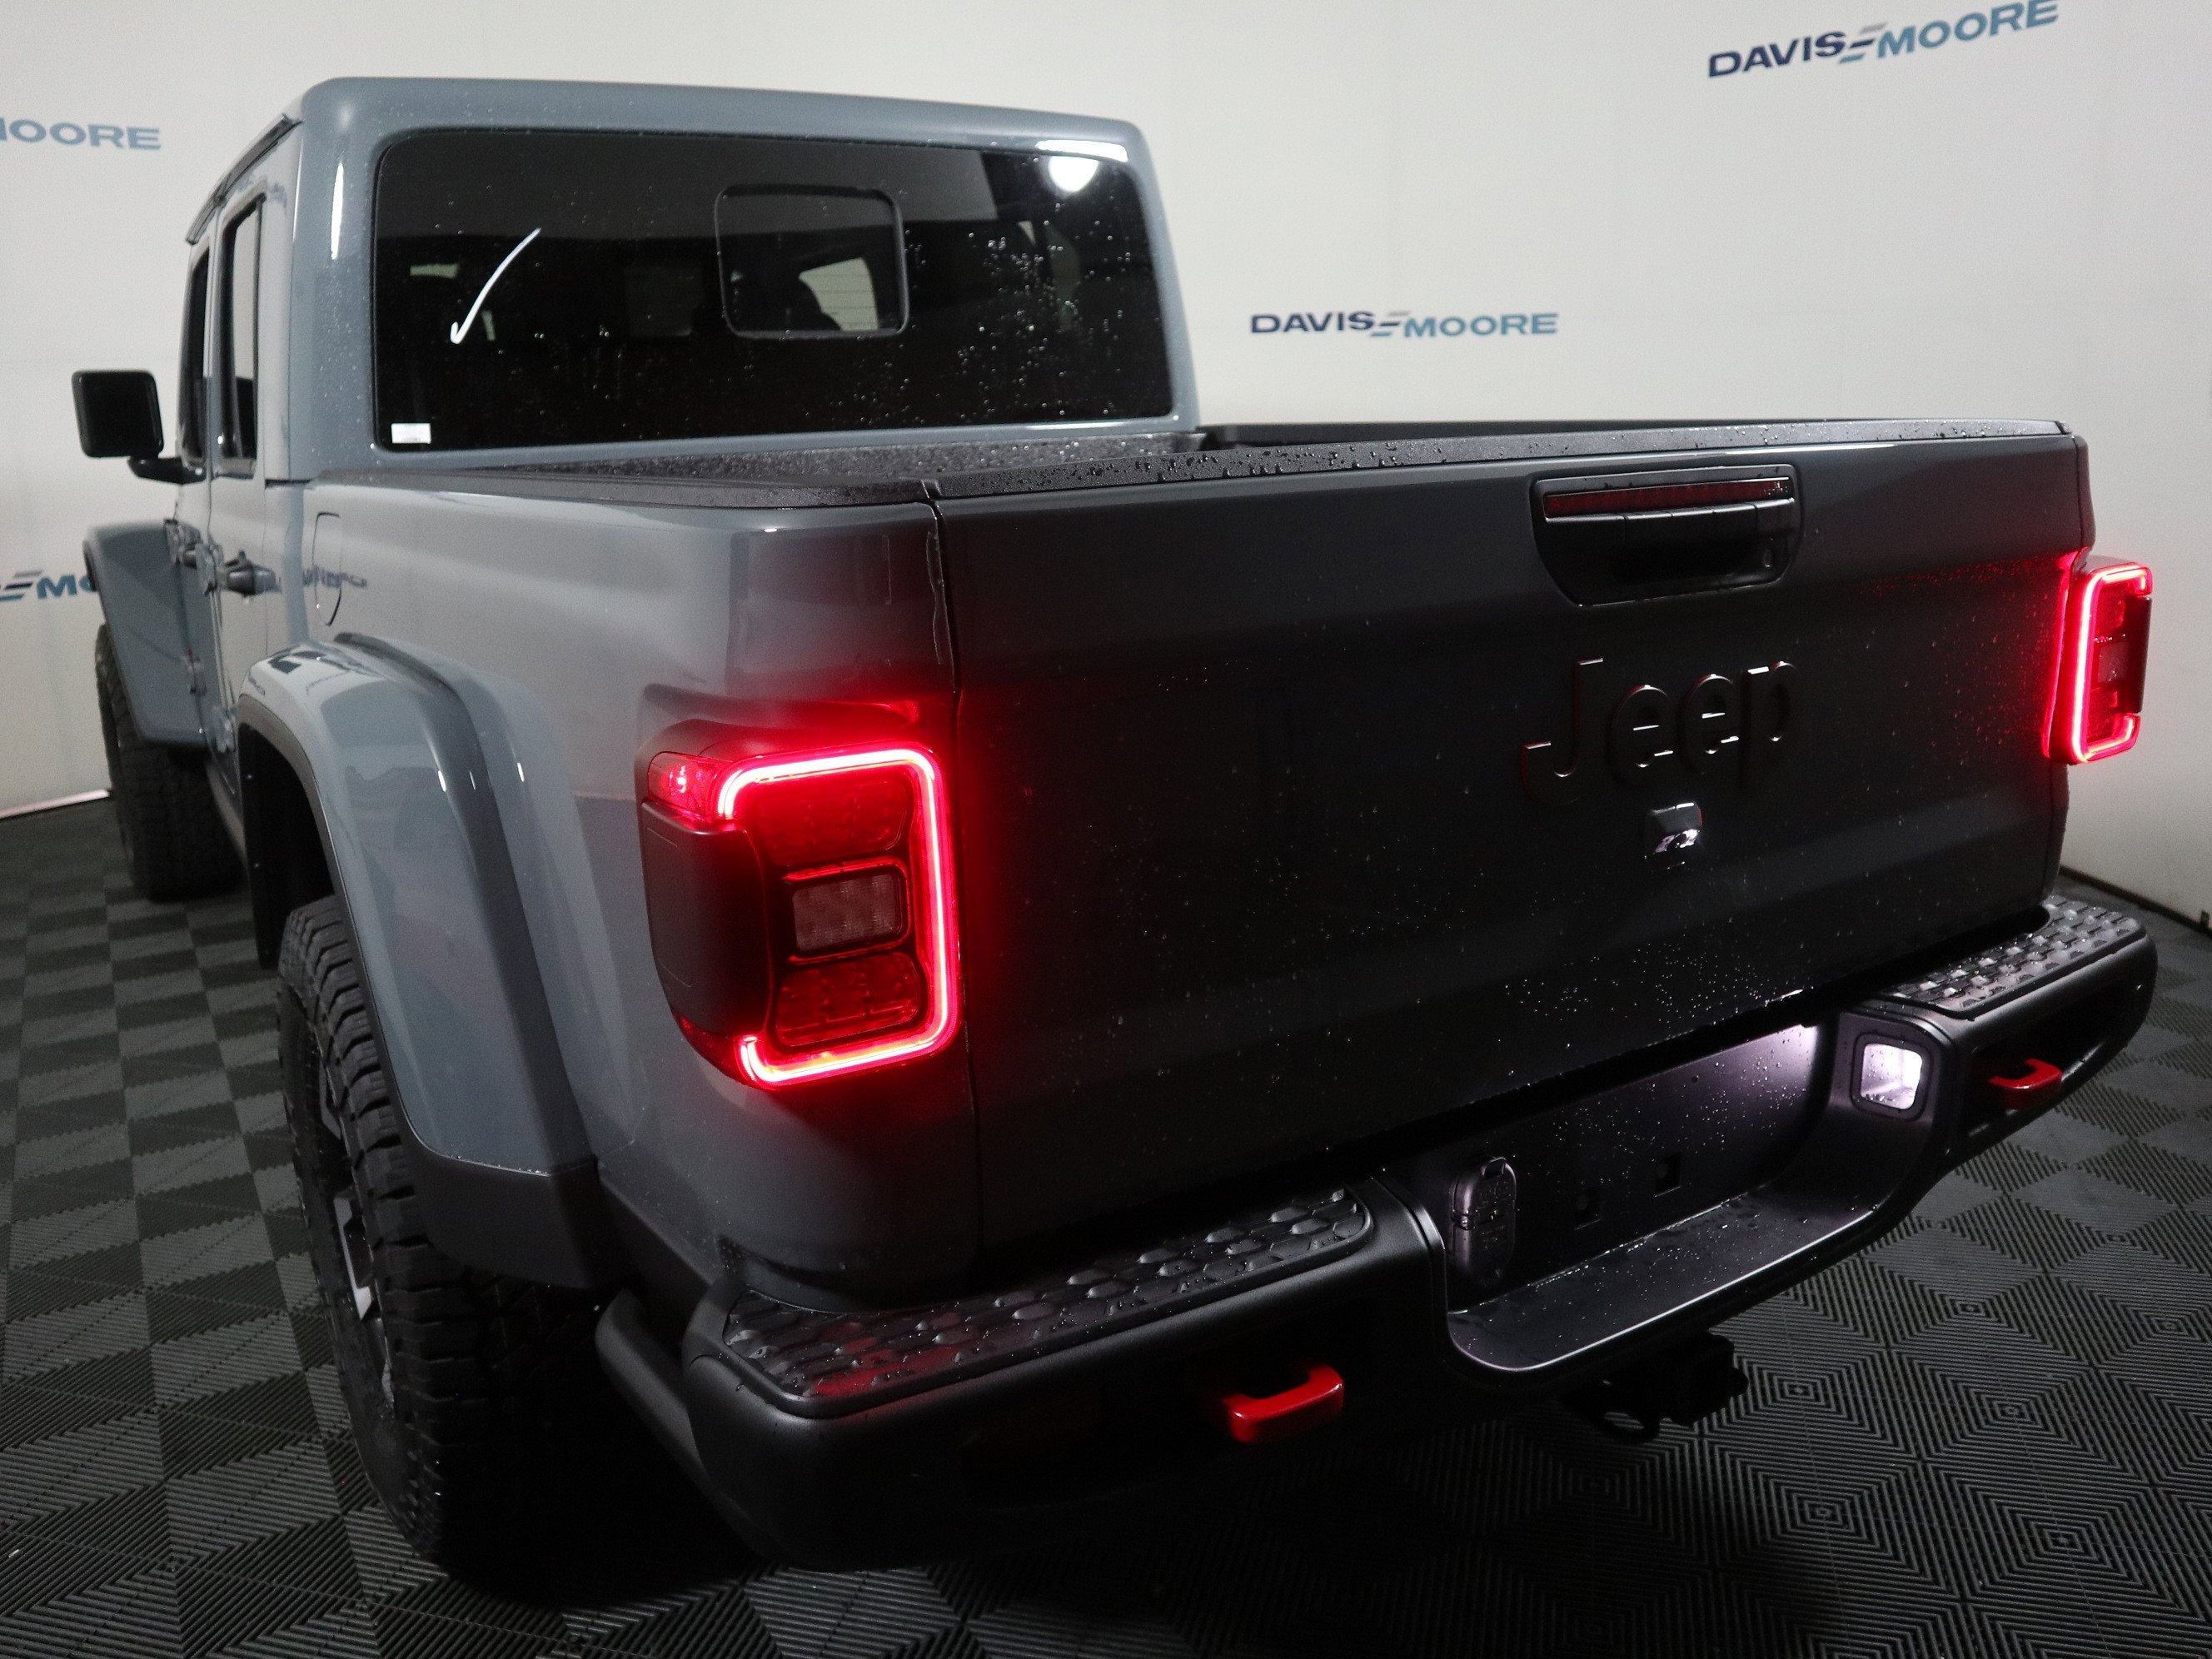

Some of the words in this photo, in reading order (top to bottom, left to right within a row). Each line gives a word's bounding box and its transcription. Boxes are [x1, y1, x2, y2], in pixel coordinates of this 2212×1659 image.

[1708, 30, 1846, 77] DAVIS
[1877, 0, 2059, 59] MOORE
[0, 117, 162, 152] OORE
[1251, 311, 1373, 334] DAVIS
[1403, 312, 1559, 338] MOORE
[1519, 656, 1801, 806] Jeep
